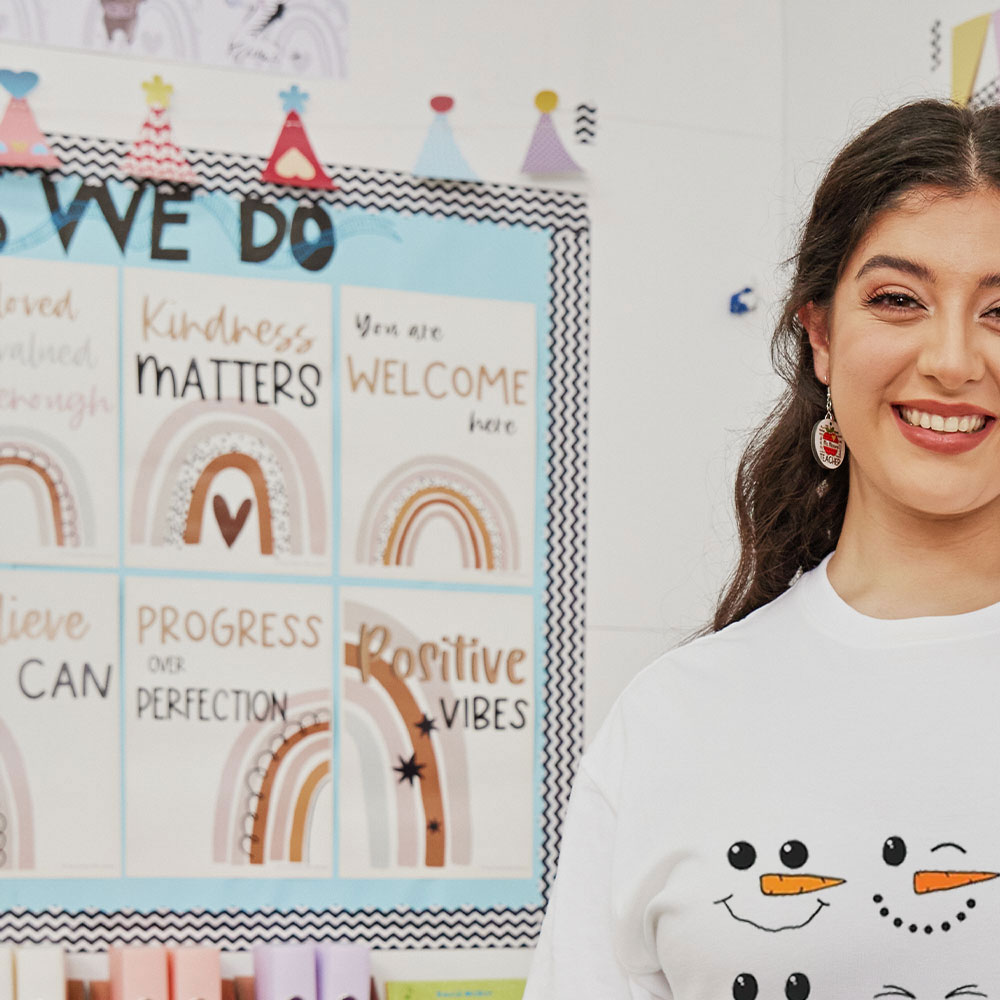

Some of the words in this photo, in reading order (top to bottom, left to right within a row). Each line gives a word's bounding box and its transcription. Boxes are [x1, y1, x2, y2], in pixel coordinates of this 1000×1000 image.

[42, 172, 193, 262] WE
[240, 198, 336, 272] DO
[139, 295, 317, 354] Kindness
[355, 311, 400, 339] You
[135, 353, 322, 408] MATTERS
[346, 353, 530, 406] WELCOME
[467, 410, 518, 435] here
[137, 604, 323, 649] PROGRESS
[149, 654, 187, 675] OVER
[358, 622, 528, 685] Positive
[18, 657, 112, 700] CAN
[136, 686, 289, 722] PERFECTION
[439, 695, 529, 731] VIBES
